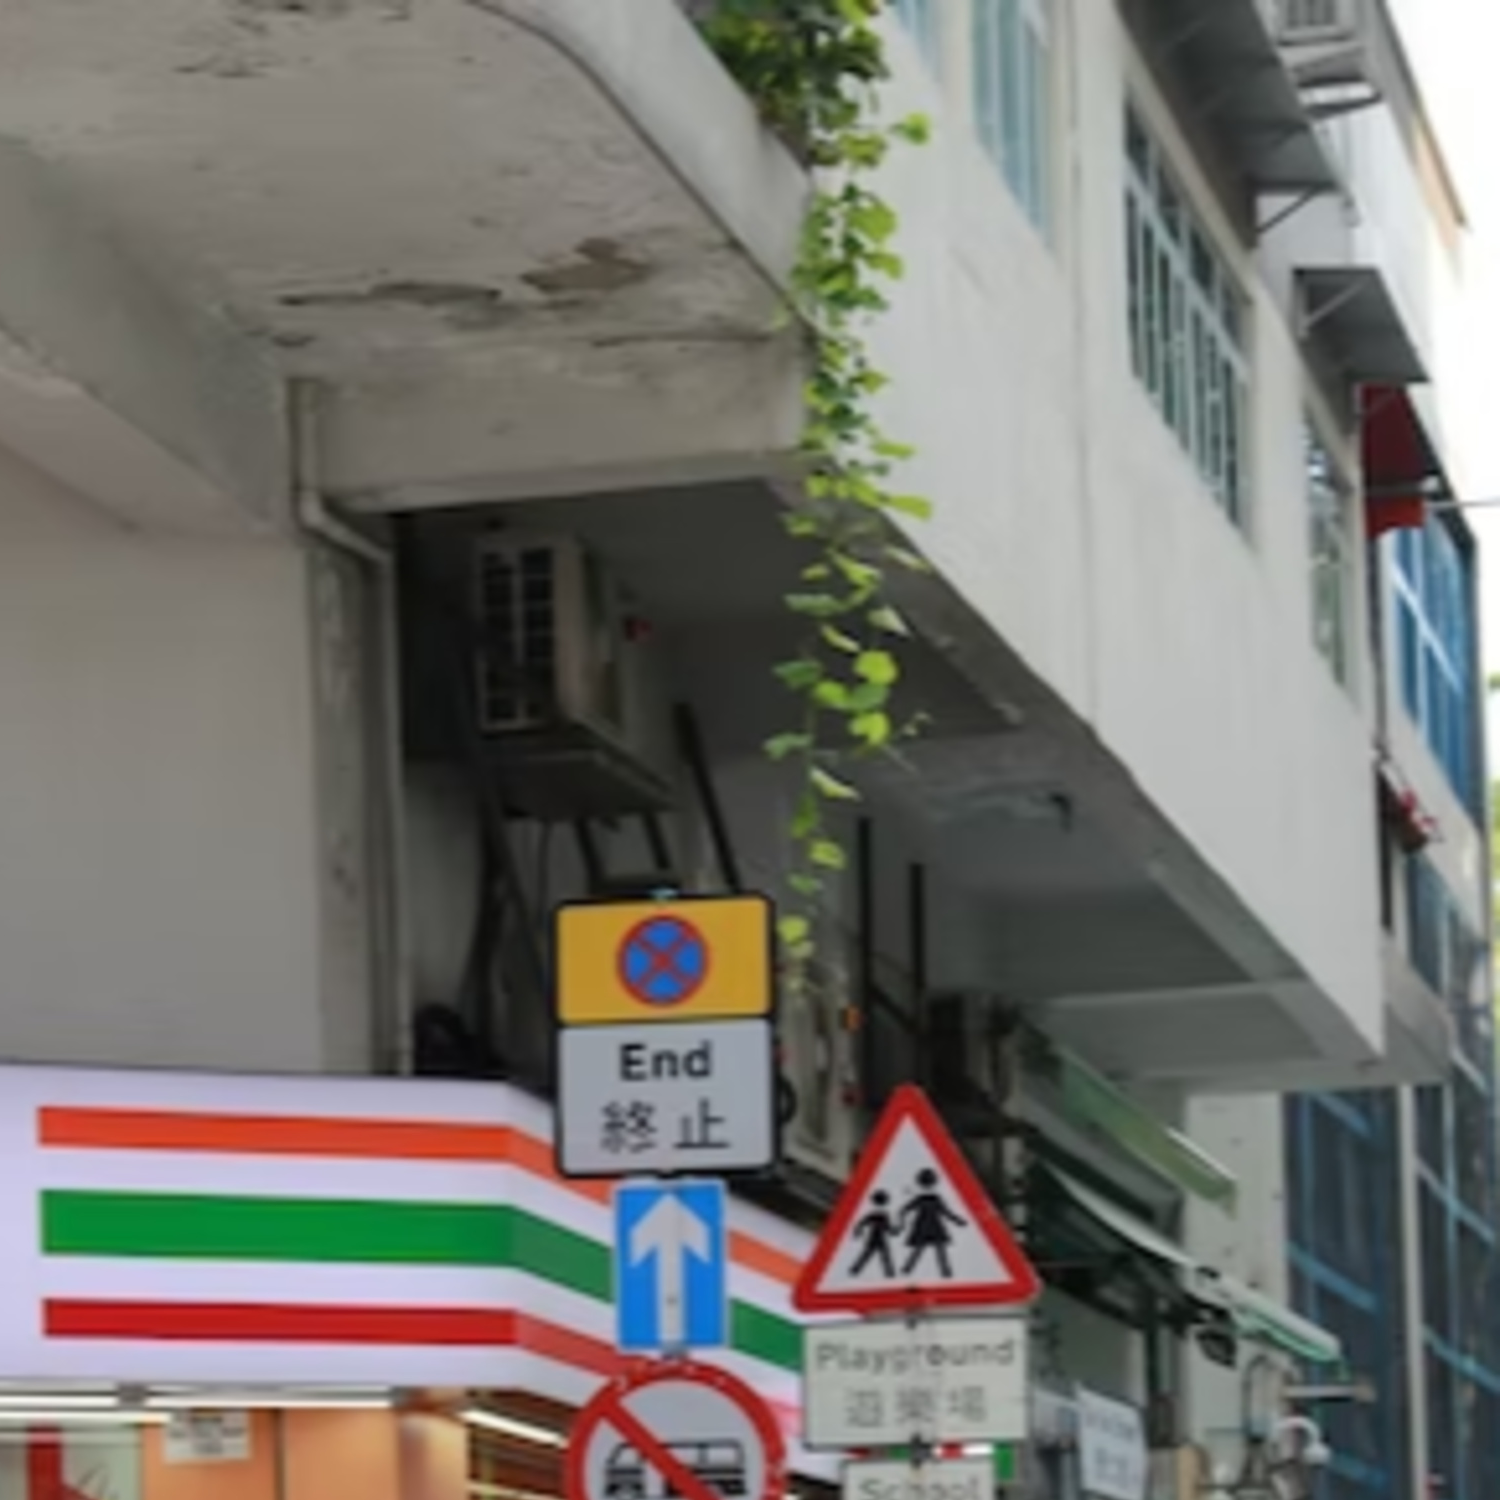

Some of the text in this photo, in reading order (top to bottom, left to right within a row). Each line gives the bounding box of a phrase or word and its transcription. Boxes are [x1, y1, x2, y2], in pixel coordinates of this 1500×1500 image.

[620, 1039, 712, 1081] End
[601, 1097, 731, 1154] 終止
[816, 1338, 1015, 1376] Playground
